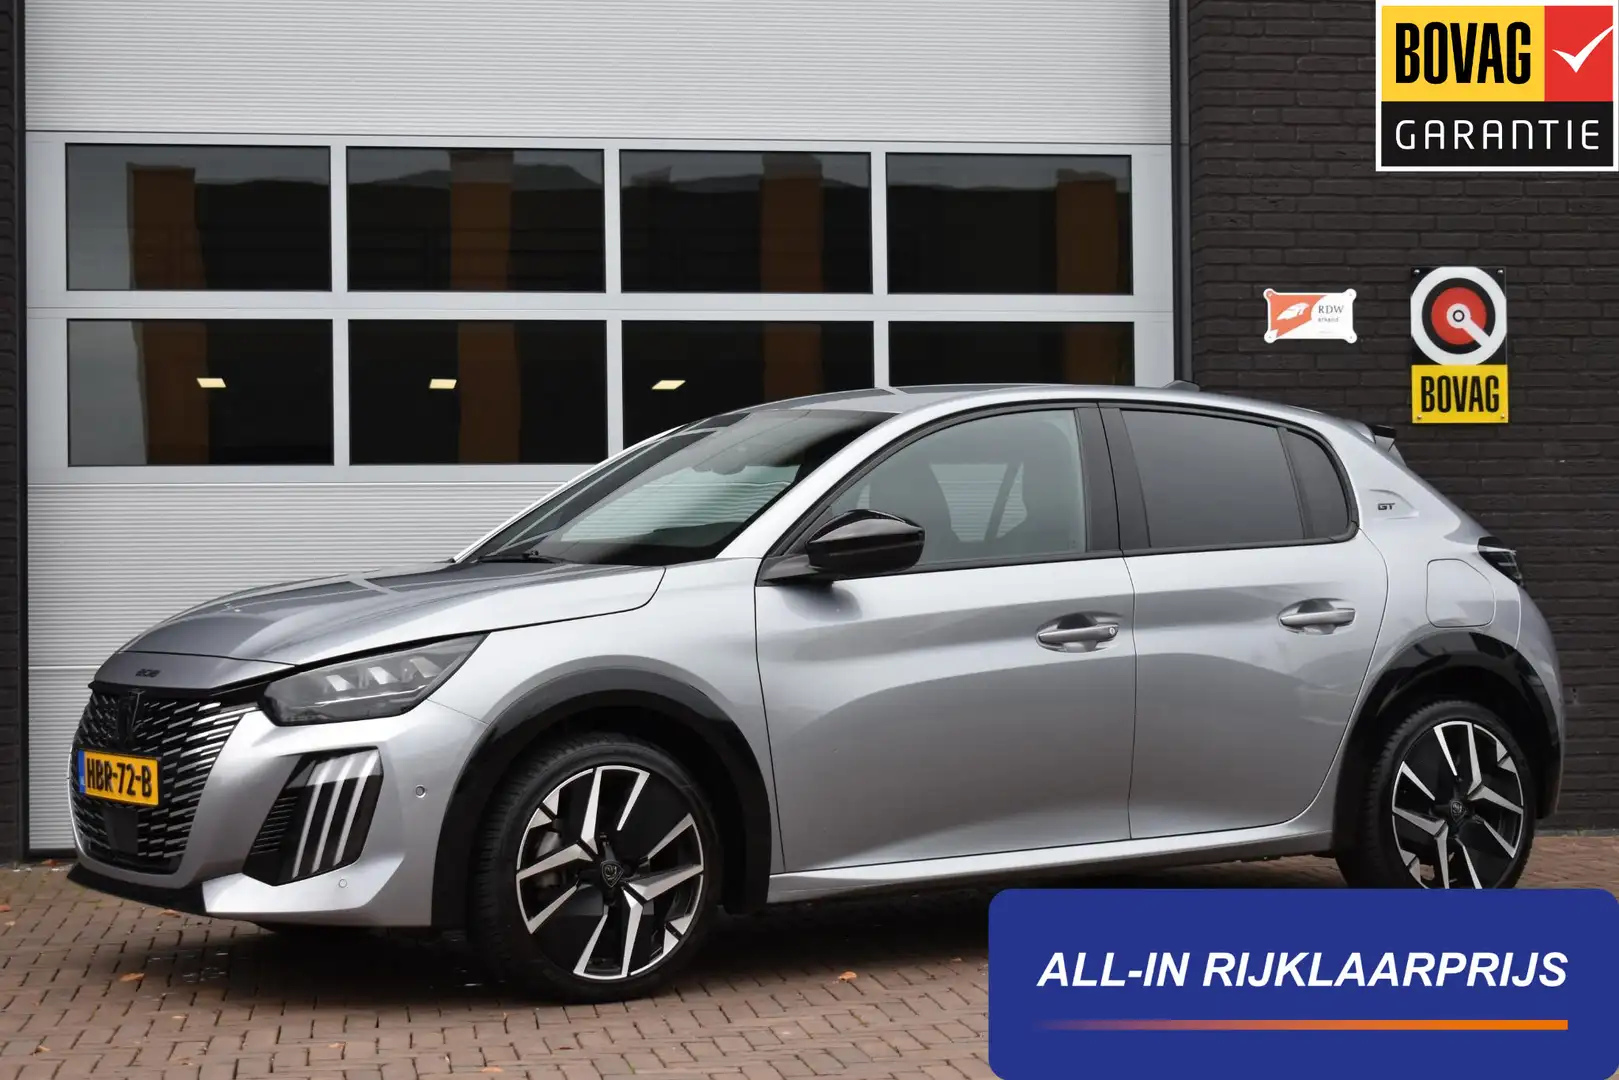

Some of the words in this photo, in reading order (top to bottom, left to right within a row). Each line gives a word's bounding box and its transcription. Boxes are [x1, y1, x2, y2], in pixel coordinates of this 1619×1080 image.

[1318, 304, 1344, 314] RDW
[1420, 374, 1500, 413] BOVAG
[1377, 502, 1396, 511] GT
[86, 757, 153, 799] HBR-72-B
